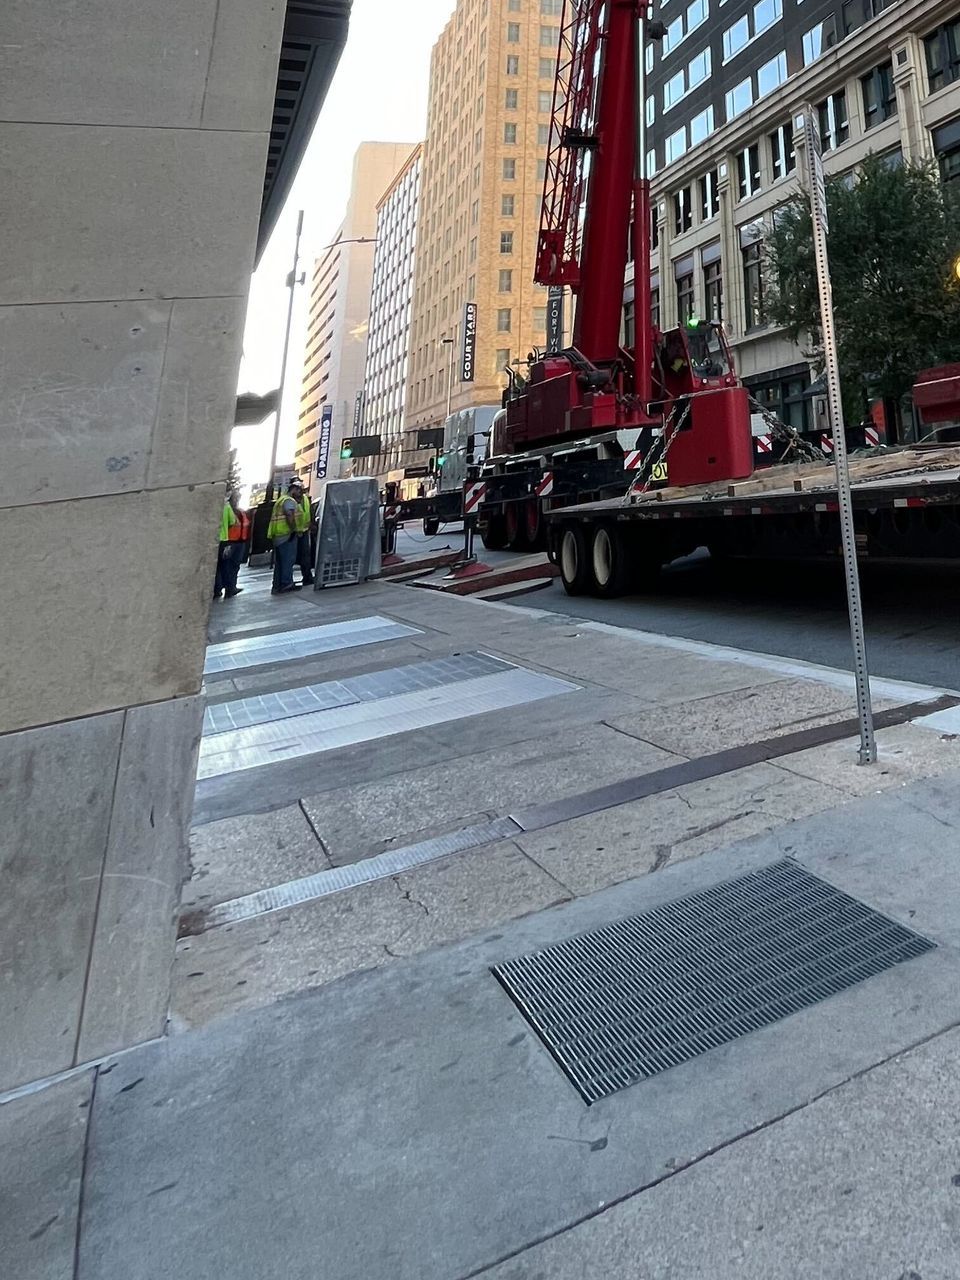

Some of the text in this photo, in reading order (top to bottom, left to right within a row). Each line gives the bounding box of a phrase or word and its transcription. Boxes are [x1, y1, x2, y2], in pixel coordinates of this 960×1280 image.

[464, 305, 474, 379] COURTYARD
[551, 301, 559, 334] FORT
[318, 419, 330, 468] PARKING
